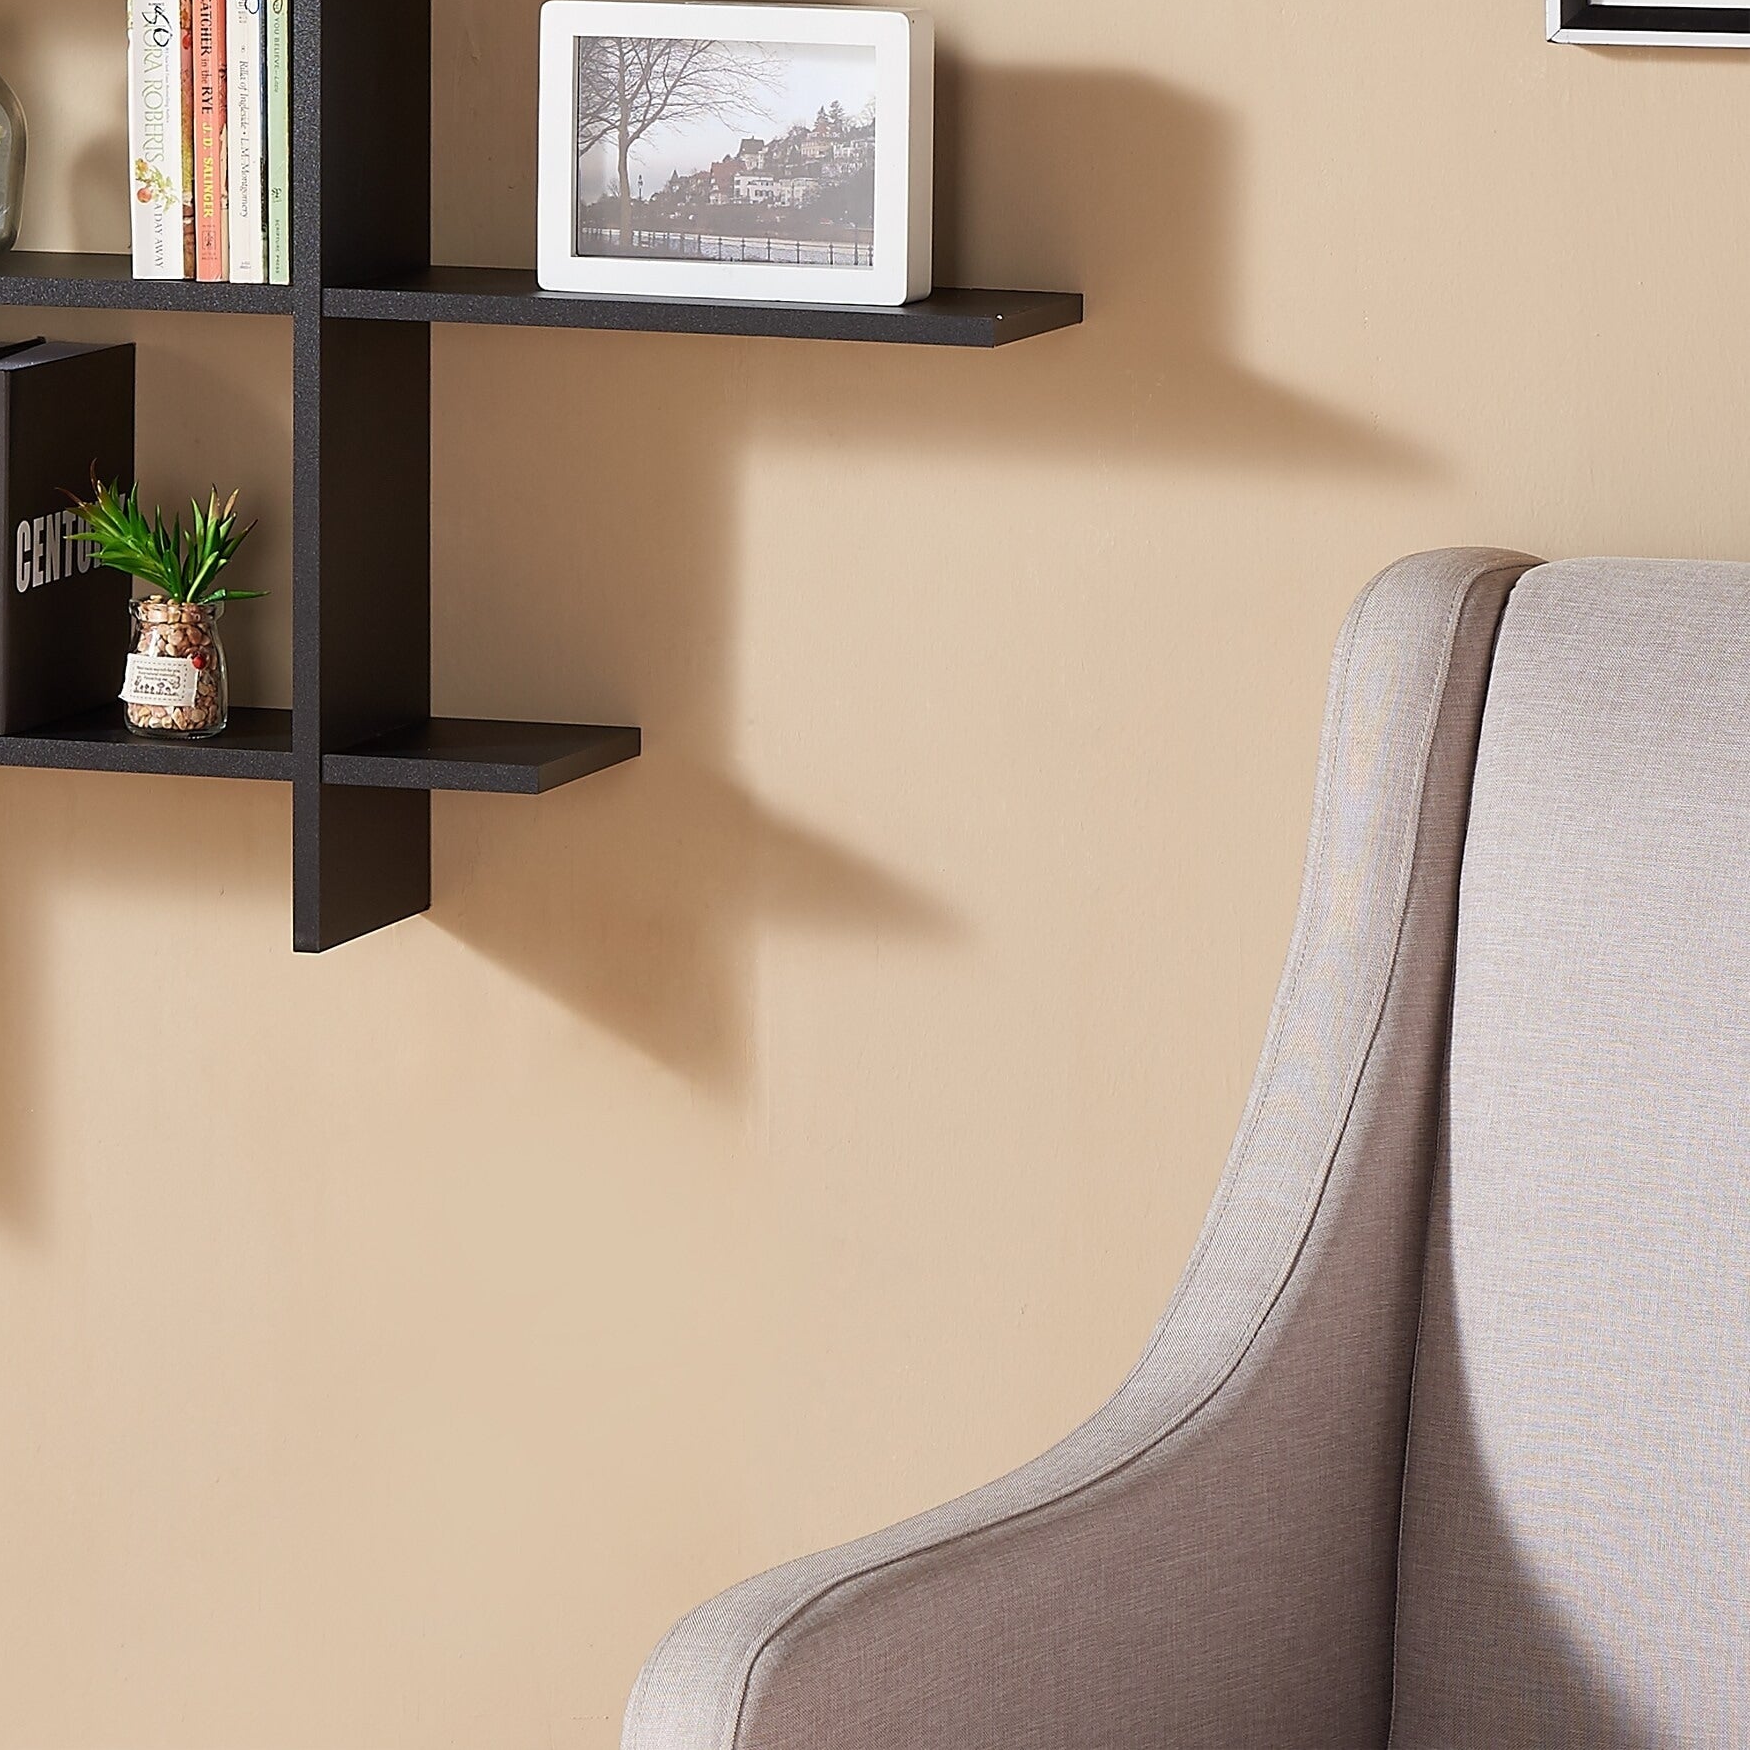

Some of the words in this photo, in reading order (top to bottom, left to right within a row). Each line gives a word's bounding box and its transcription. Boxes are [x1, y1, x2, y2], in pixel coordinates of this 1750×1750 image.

[142, 80, 164, 163] ROBERTS
[201, 86, 213, 115] RYE
[154, 203, 162, 212] A
[203, 157, 214, 218] SALINGER
[238, 163, 250, 218] Montgomery
[154, 213, 162, 235] DAY
[154, 239, 164, 269] AWAY
[16, 493, 127, 593] CENTU
